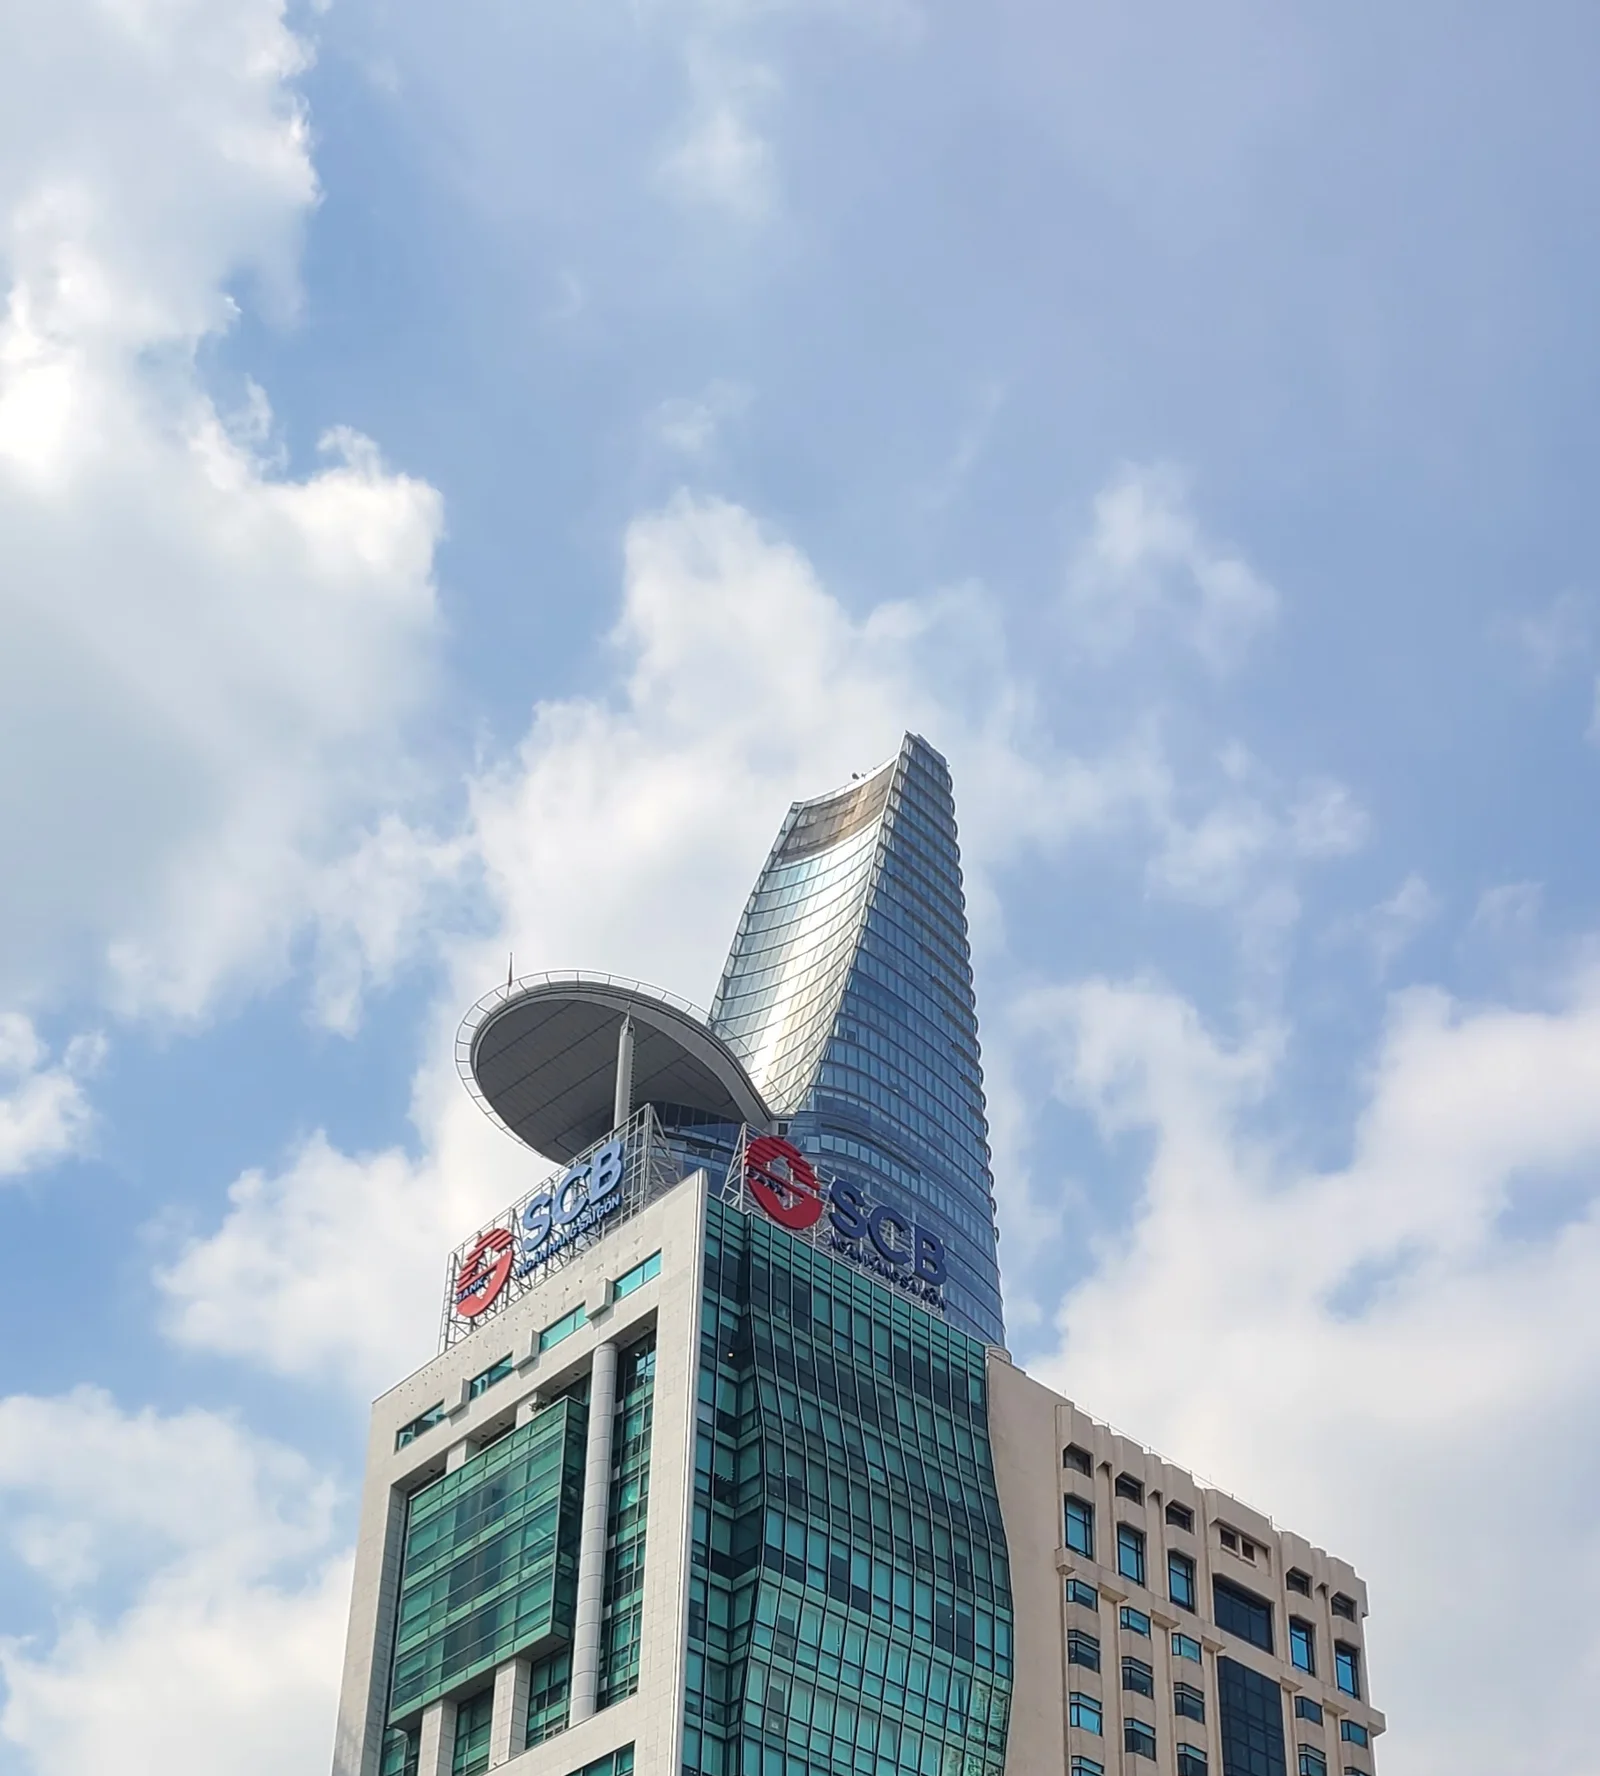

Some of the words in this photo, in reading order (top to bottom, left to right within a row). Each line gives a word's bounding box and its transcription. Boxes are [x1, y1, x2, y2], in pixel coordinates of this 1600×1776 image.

[521, 1139, 625, 1252] SCB
[828, 1177, 947, 1287] SCB
[455, 1278, 486, 1303] BANK
